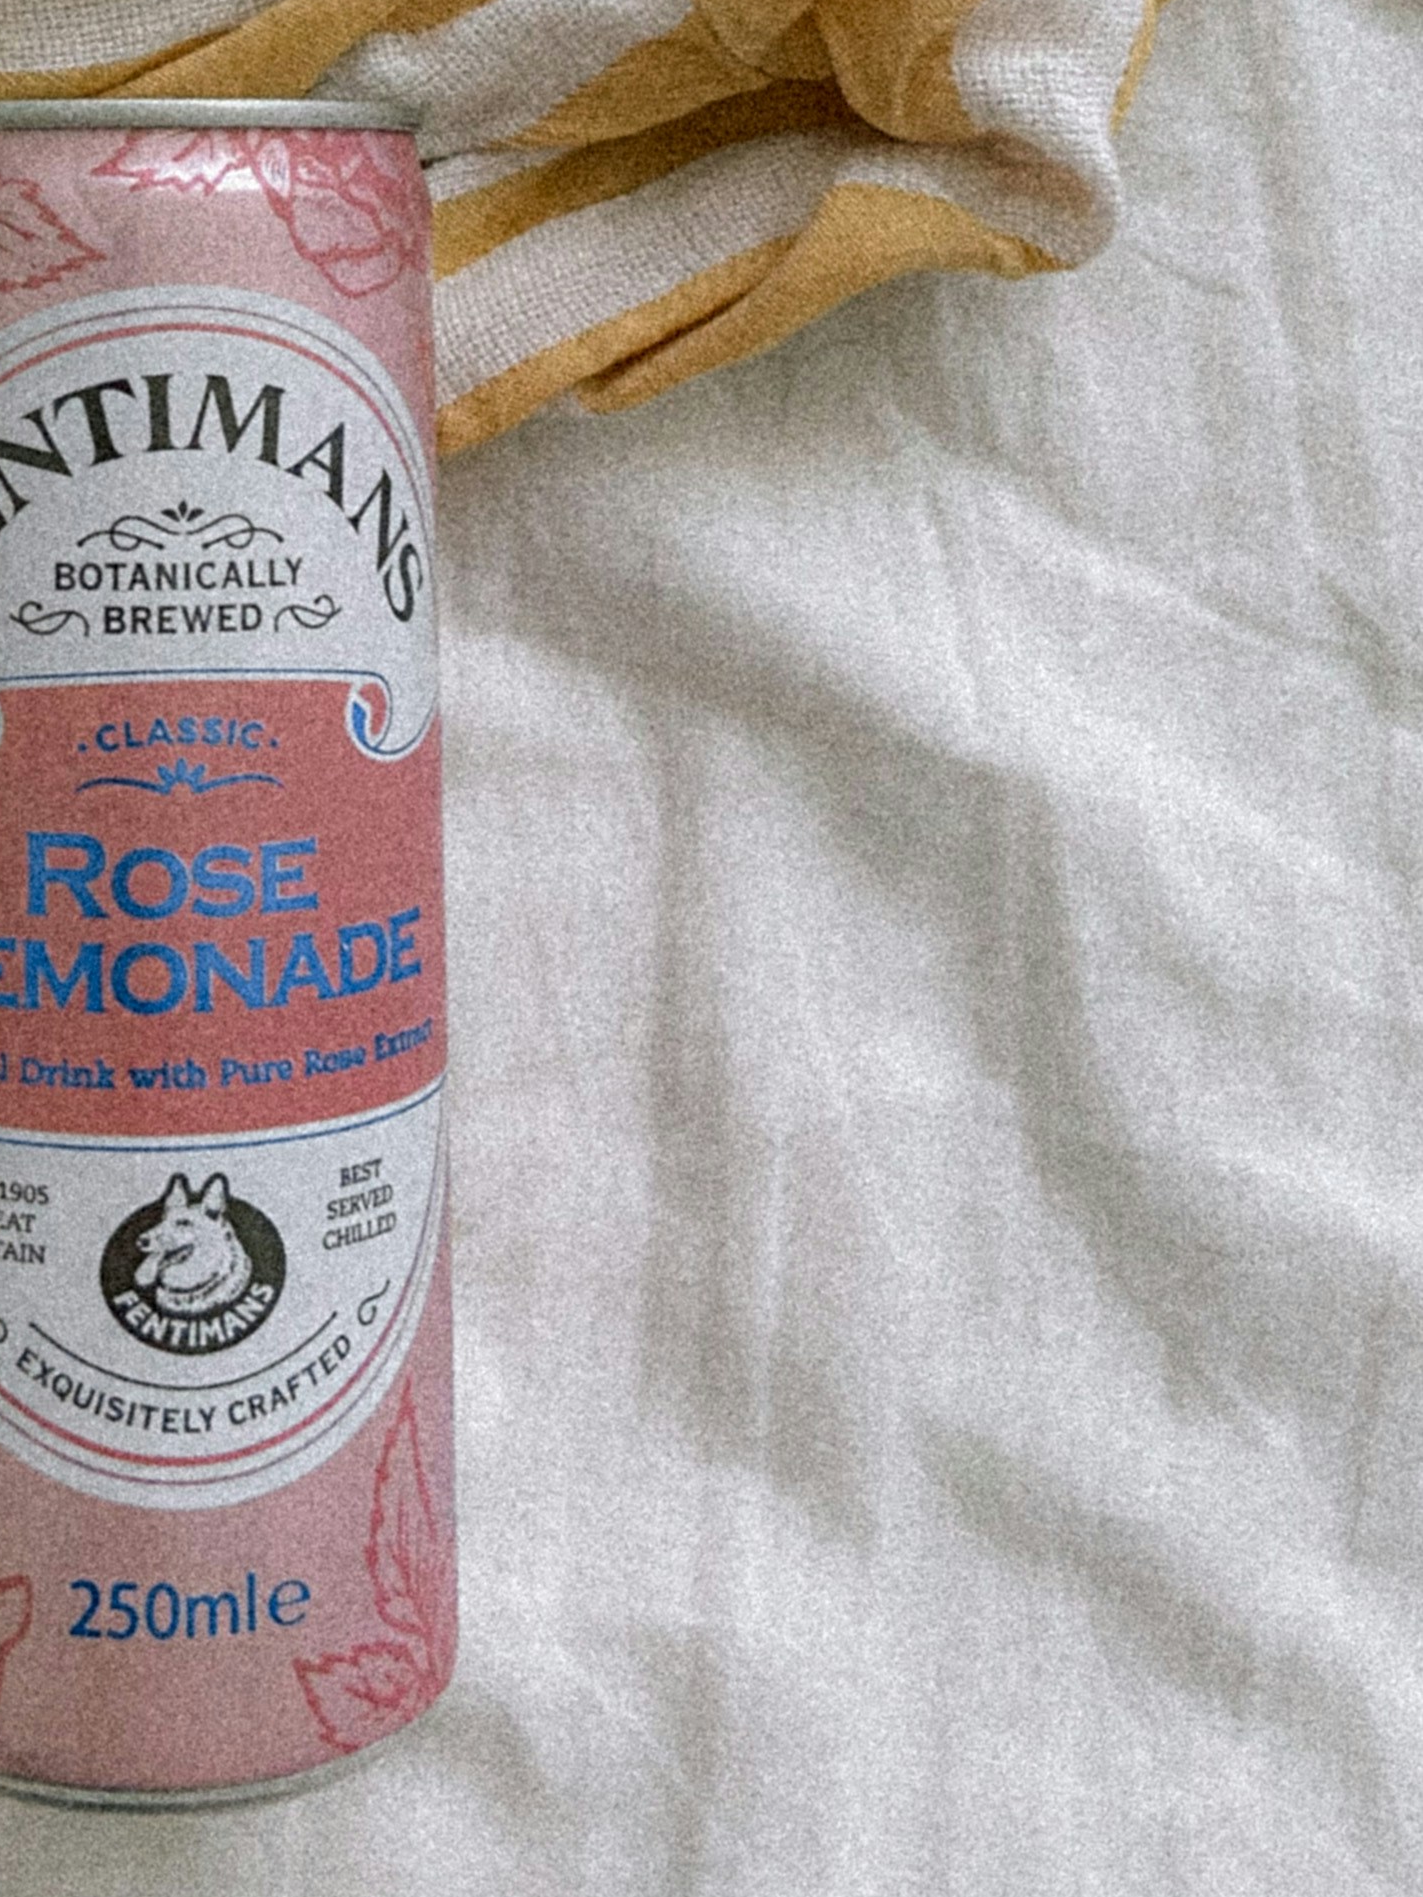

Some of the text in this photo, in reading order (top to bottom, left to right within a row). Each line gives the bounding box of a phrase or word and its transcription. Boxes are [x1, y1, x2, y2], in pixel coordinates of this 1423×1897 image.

[54, 557, 303, 592] BOTANICALLY
[103, 603, 263, 635] BREWED
[95, 716, 265, 752] CLASSIC
[26, 831, 320, 919] ROSE
[20, 1056, 115, 1090] Drink
[129, 1064, 207, 1090] with
[220, 1055, 293, 1087] Pure
[304, 1046, 366, 1078] Rose
[339, 1156, 382, 1188] BEST
[326, 1184, 394, 1221] SERVED
[322, 1211, 397, 1250] CHILLED
[113, 1281, 276, 1349] FENTIMANS
[15, 1333, 353, 1434] EXQUISITELY CRAFTED
